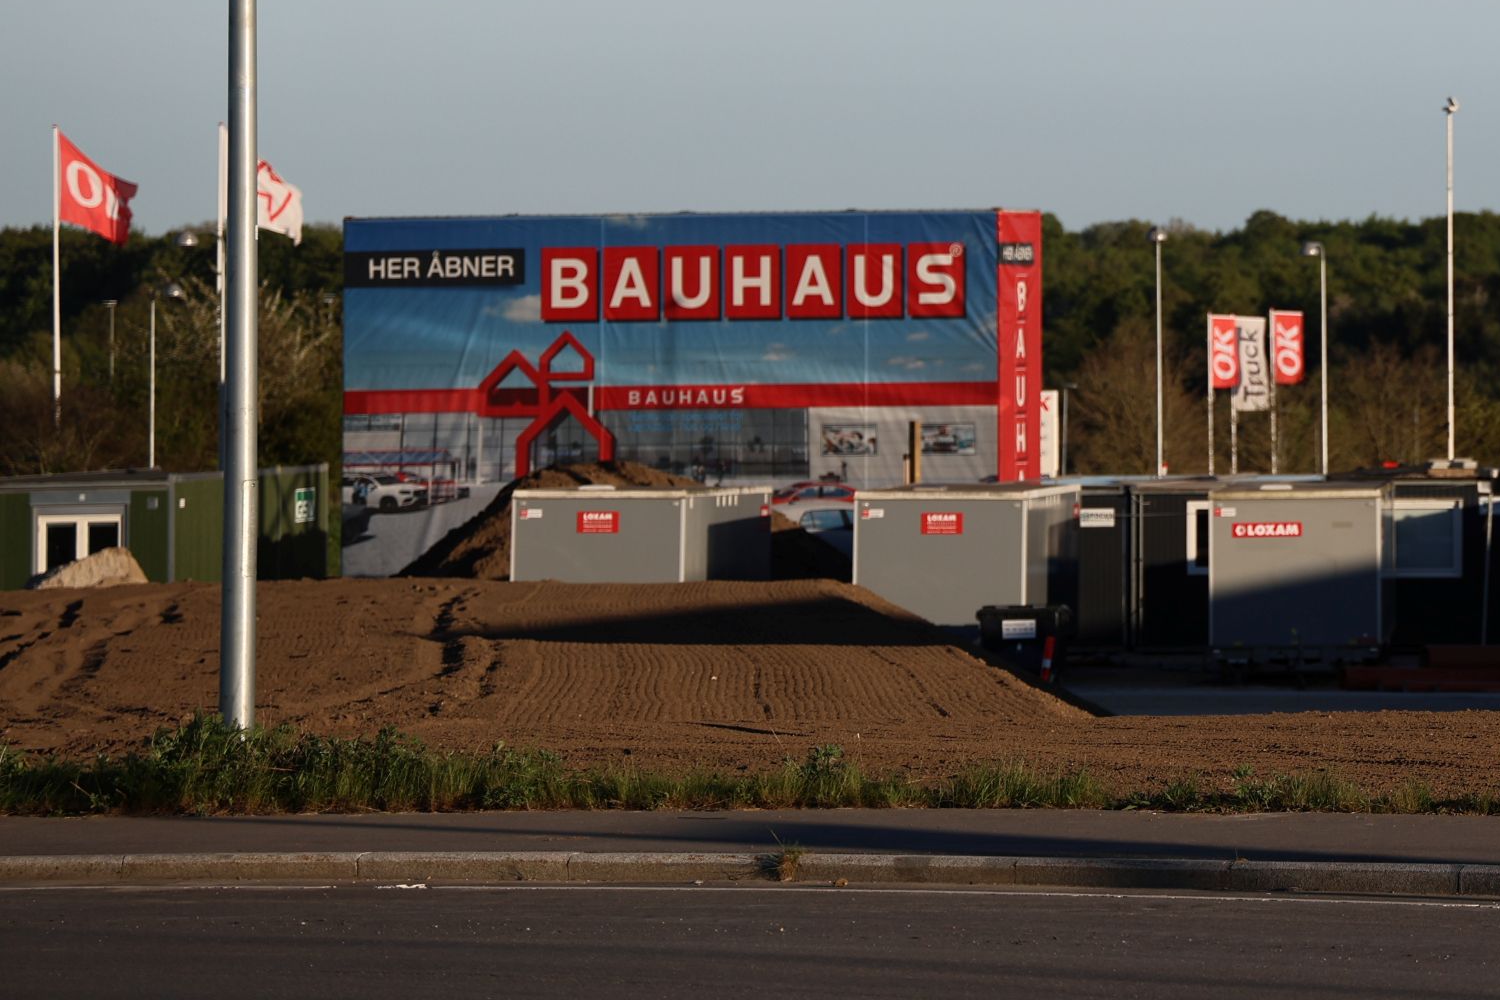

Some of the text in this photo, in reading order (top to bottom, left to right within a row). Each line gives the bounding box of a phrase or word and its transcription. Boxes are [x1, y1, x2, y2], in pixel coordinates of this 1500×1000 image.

[368, 250, 514, 279] HER ÅBNER
[1213, 327, 1237, 380] OK
[1239, 329, 1265, 402] Truck
[1276, 322, 1301, 377] OK
